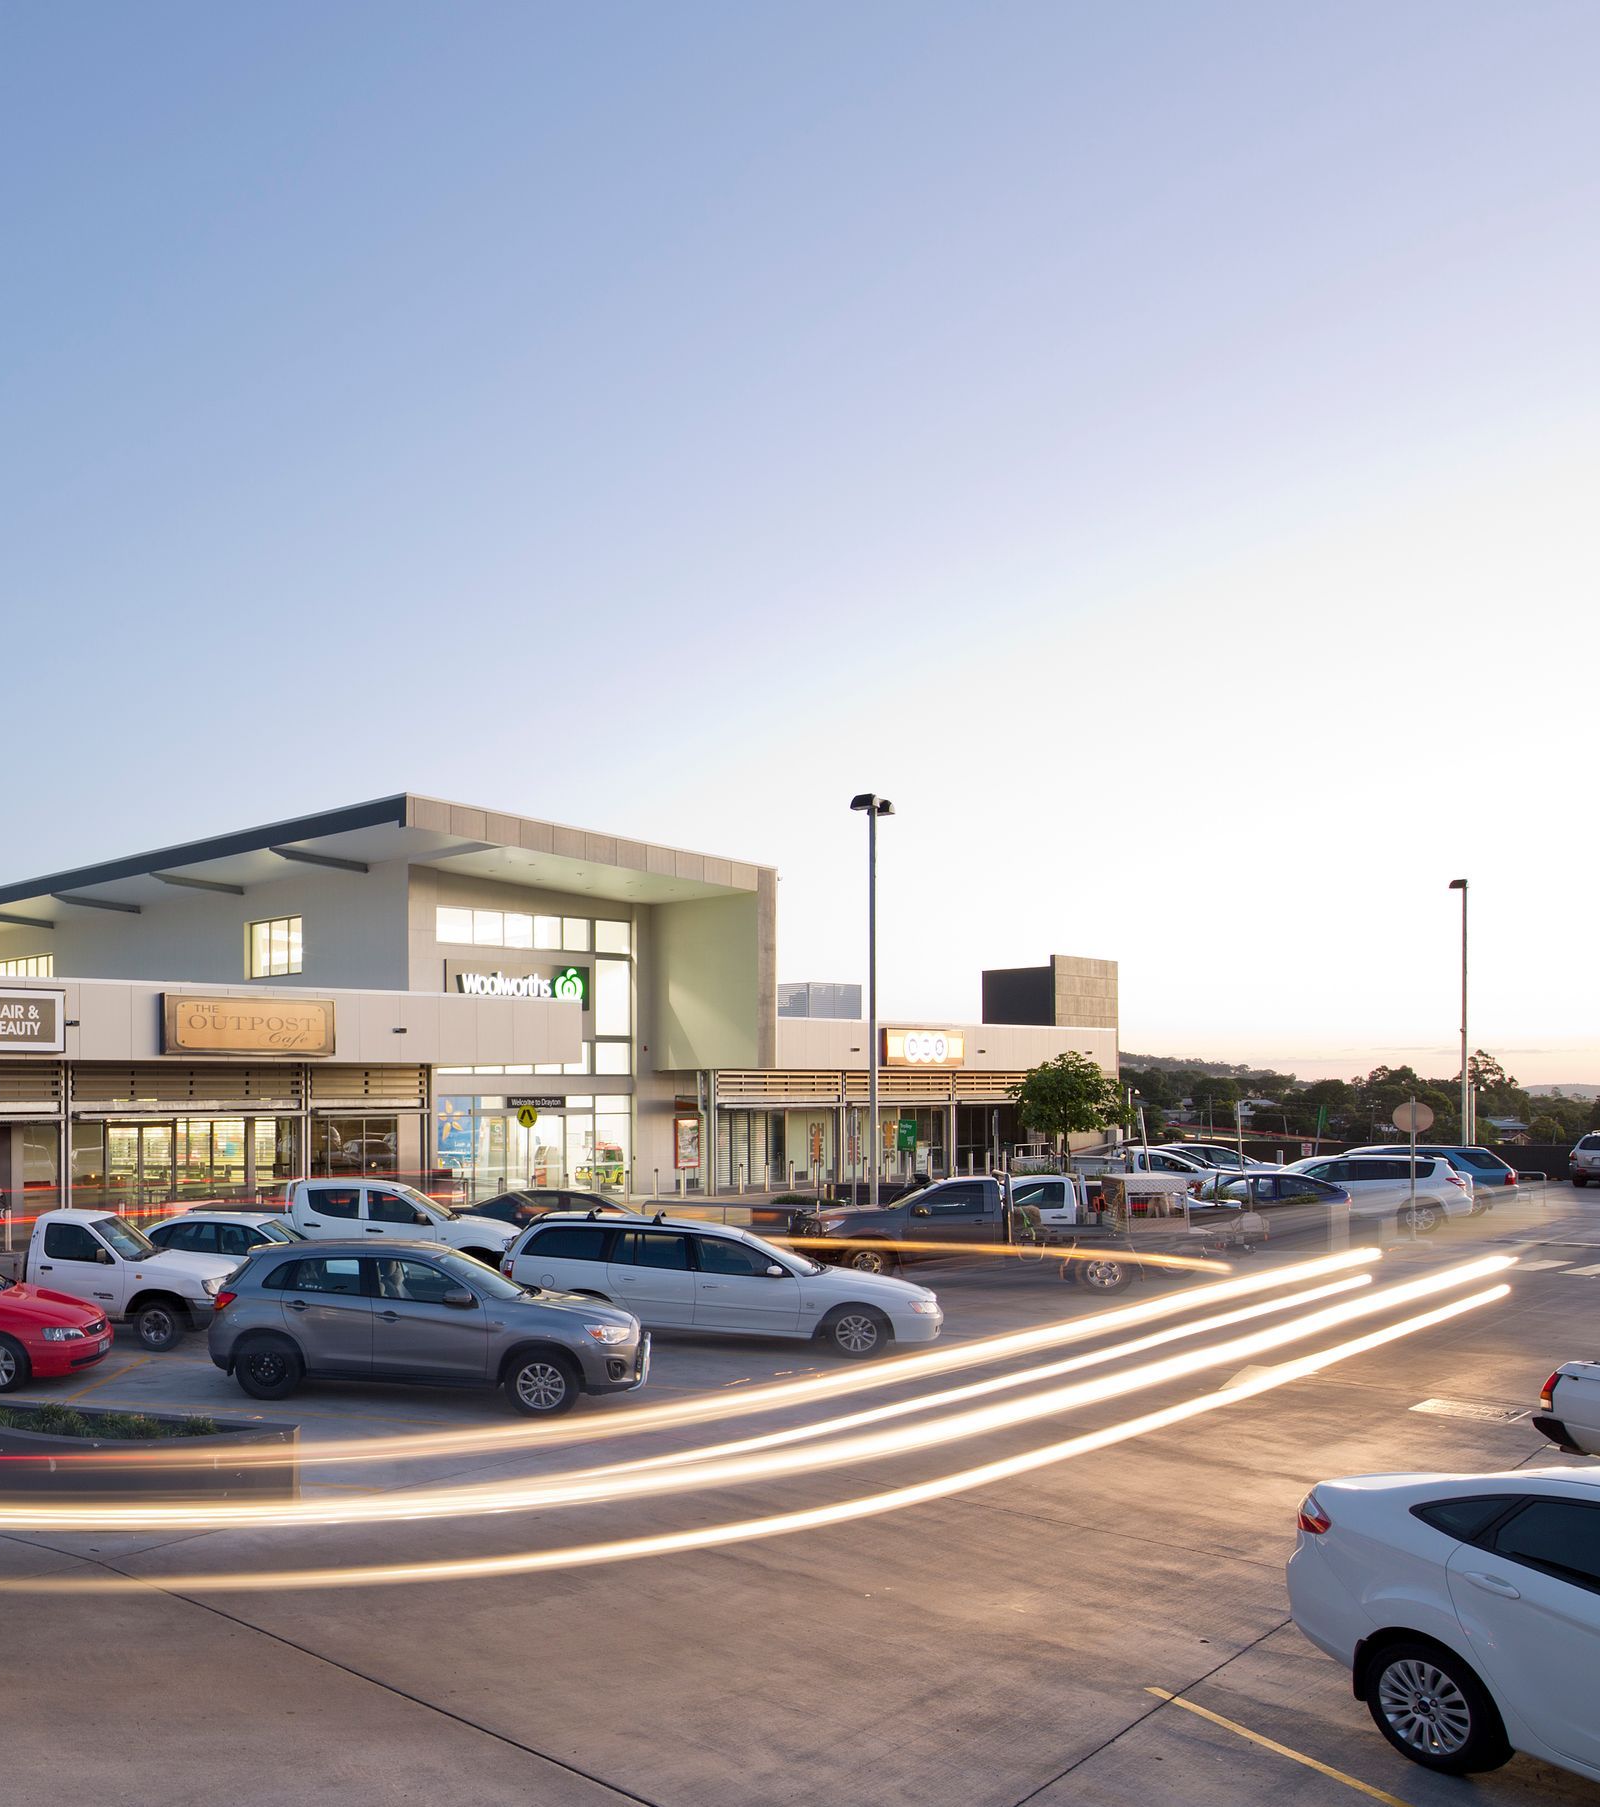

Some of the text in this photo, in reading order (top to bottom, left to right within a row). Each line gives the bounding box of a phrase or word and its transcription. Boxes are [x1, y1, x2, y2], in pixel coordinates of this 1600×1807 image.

[461, 971, 552, 998] Woolworths
[27, 1006, 40, 1020] &
[194, 1004, 220, 1014] THE
[188, 1014, 317, 1032] OUTPOST
[511, 1098, 534, 1106] Welcome
[541, 1098, 561, 1107] Drayton
